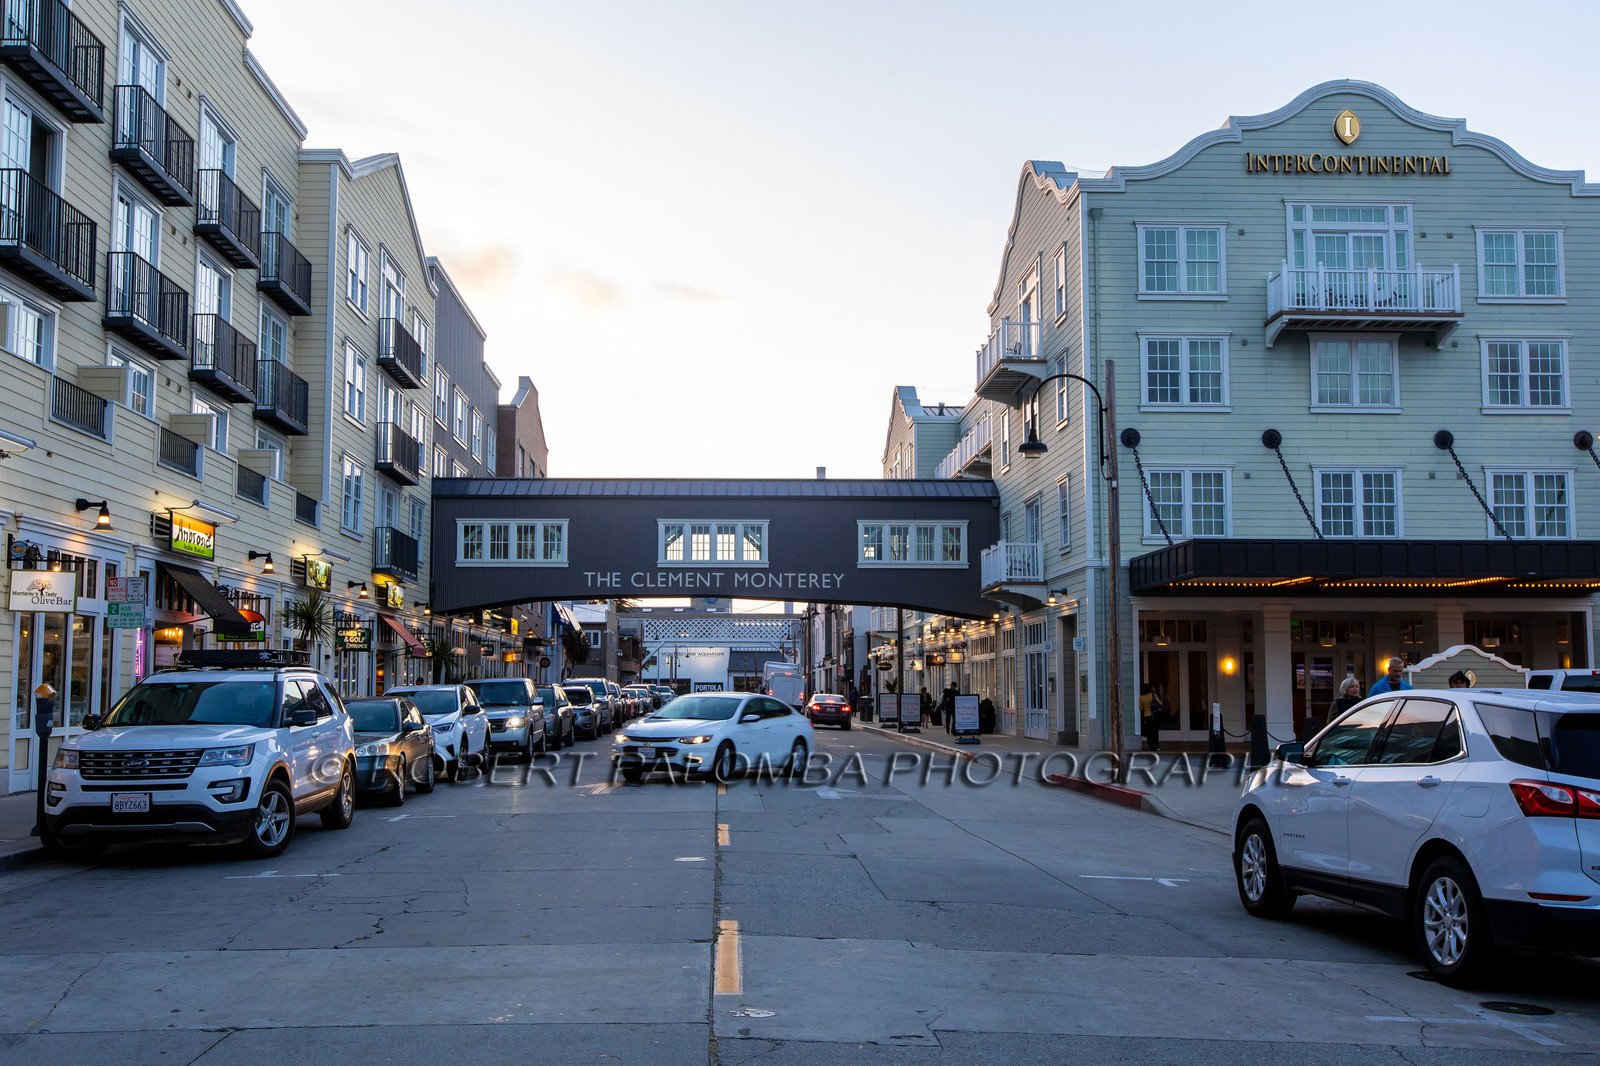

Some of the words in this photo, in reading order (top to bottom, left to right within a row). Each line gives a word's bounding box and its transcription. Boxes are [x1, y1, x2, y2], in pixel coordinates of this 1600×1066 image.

[1246, 152, 1452, 175] INTERCONTINENTAL
[174, 519, 212, 549] Ambrosia
[110, 579, 117, 587] NO
[584, 572, 621, 587] THE
[631, 572, 725, 588] CLEMENT
[734, 573, 845, 589] MONTEREY
[111, 605, 117, 614] 2
[696, 684, 722, 692] PORTOLA
[115, 801, 146, 809] 8BYZ663
